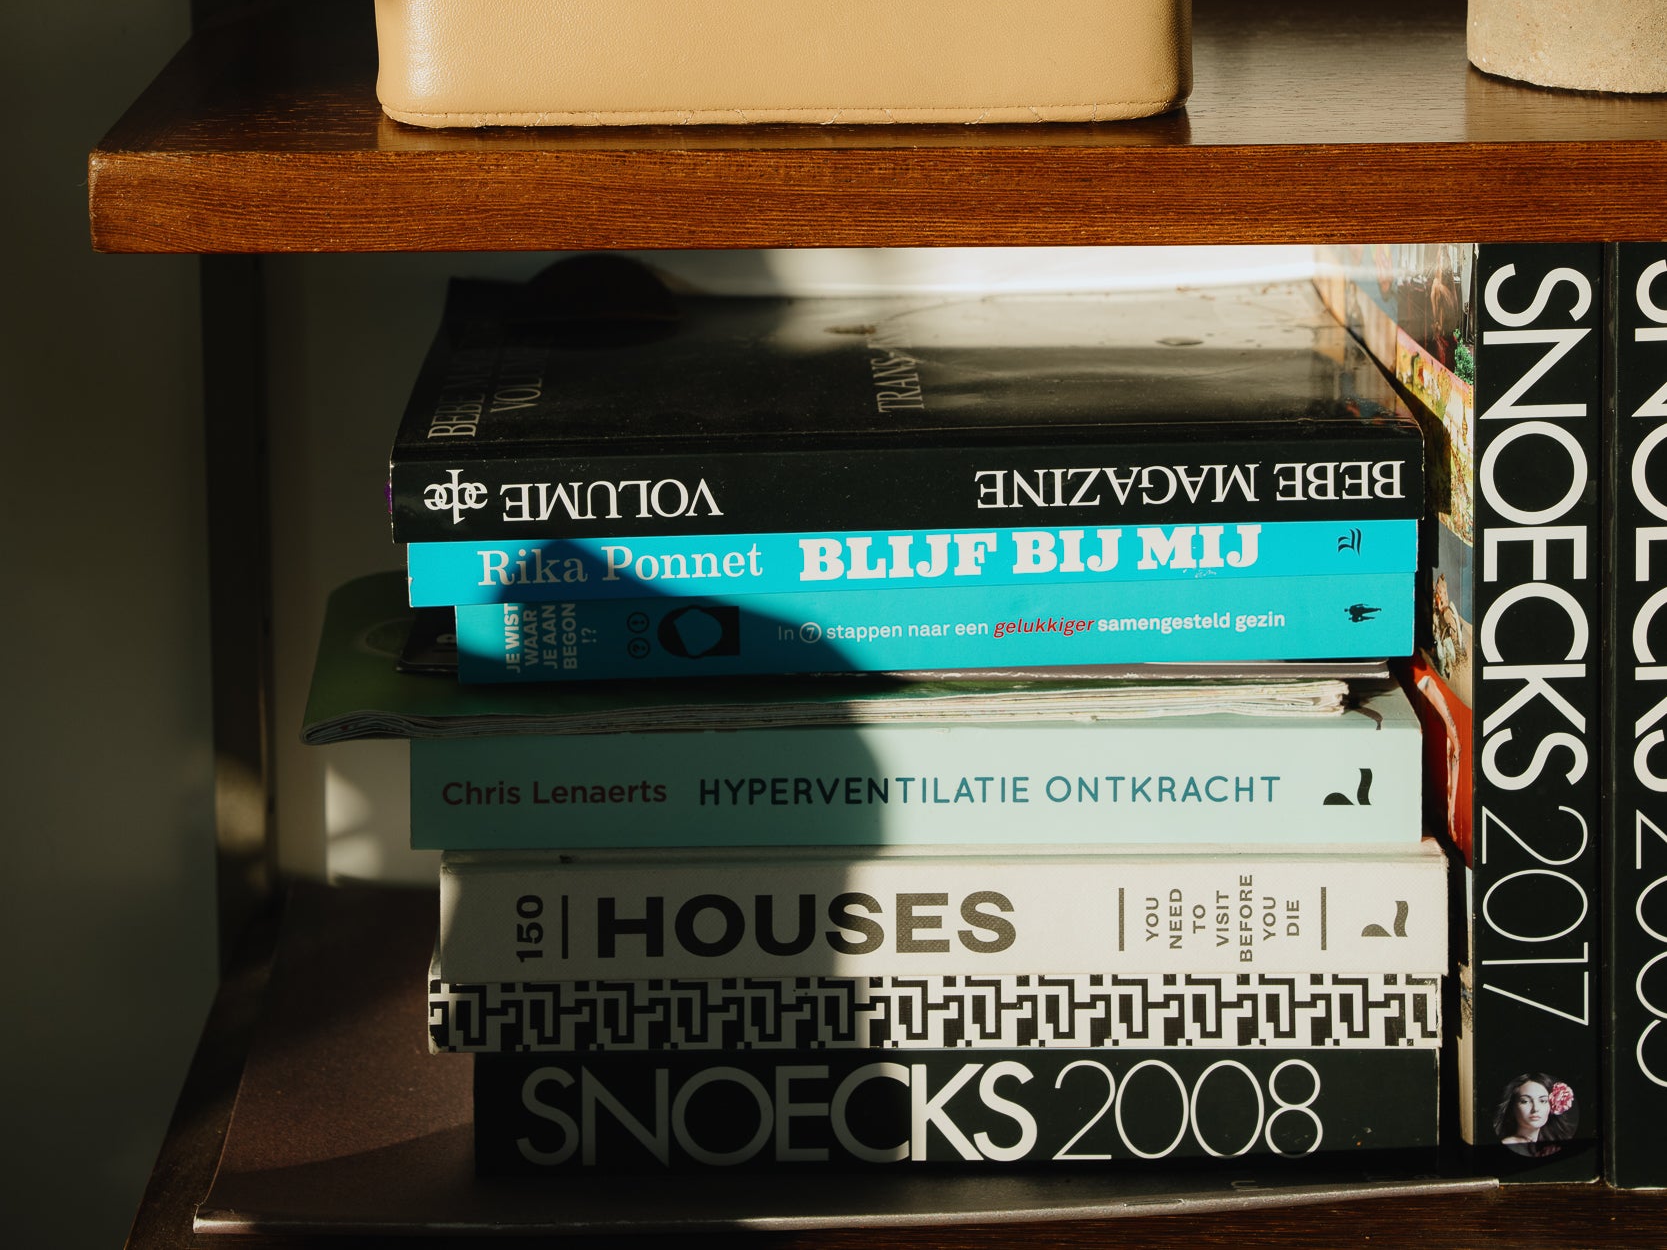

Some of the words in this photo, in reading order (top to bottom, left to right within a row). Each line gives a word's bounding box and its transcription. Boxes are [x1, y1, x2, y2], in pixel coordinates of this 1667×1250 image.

[499, 478, 724, 522] VOLUME
[974, 463, 1260, 509] MAGAZINE
[1273, 460, 1406, 502] BEBE
[1479, 262, 1592, 791] SNOECKS
[476, 549, 589, 587] Rika
[601, 542, 763, 582] Ponnet
[799, 532, 997, 581] BLIJF
[1012, 528, 1123, 575] BIJ
[1137, 524, 1262, 570] MIJ
[503, 603, 520, 649] WIST
[523, 609, 540, 667] WAAR
[541, 605, 558, 645] AAN
[561, 603, 578, 670] BEGON
[826, 622, 903, 642] stappen
[908, 622, 951, 637] naar
[955, 621, 989, 636] een
[993, 615, 1095, 639] gelukkiger
[1098, 611, 1231, 636] samengesteld
[1235, 611, 1286, 633] gezin
[506, 653, 520, 673] JE
[543, 649, 558, 670] JE
[442, 779, 521, 807] Chris
[532, 780, 668, 806] Lenaerts
[699, 776, 1030, 806] HYPERVENTILATIE
[1045, 775, 1281, 804] ONTKRACHT
[516, 894, 544, 963] 150
[597, 891, 1017, 959] HOUSES
[1145, 896, 1160, 942] YOU
[1168, 887, 1183, 950] NEED
[1192, 903, 1207, 934] TO
[1216, 890, 1230, 947] VISIT
[1239, 874, 1254, 963] BEFORE
[1262, 896, 1277, 941] YOU
[1286, 898, 1300, 937] DIE
[1481, 805, 1589, 1026] 2017
[515, 1060, 1038, 1167] SNOECKS
[1052, 1059, 1324, 1160] 2008
